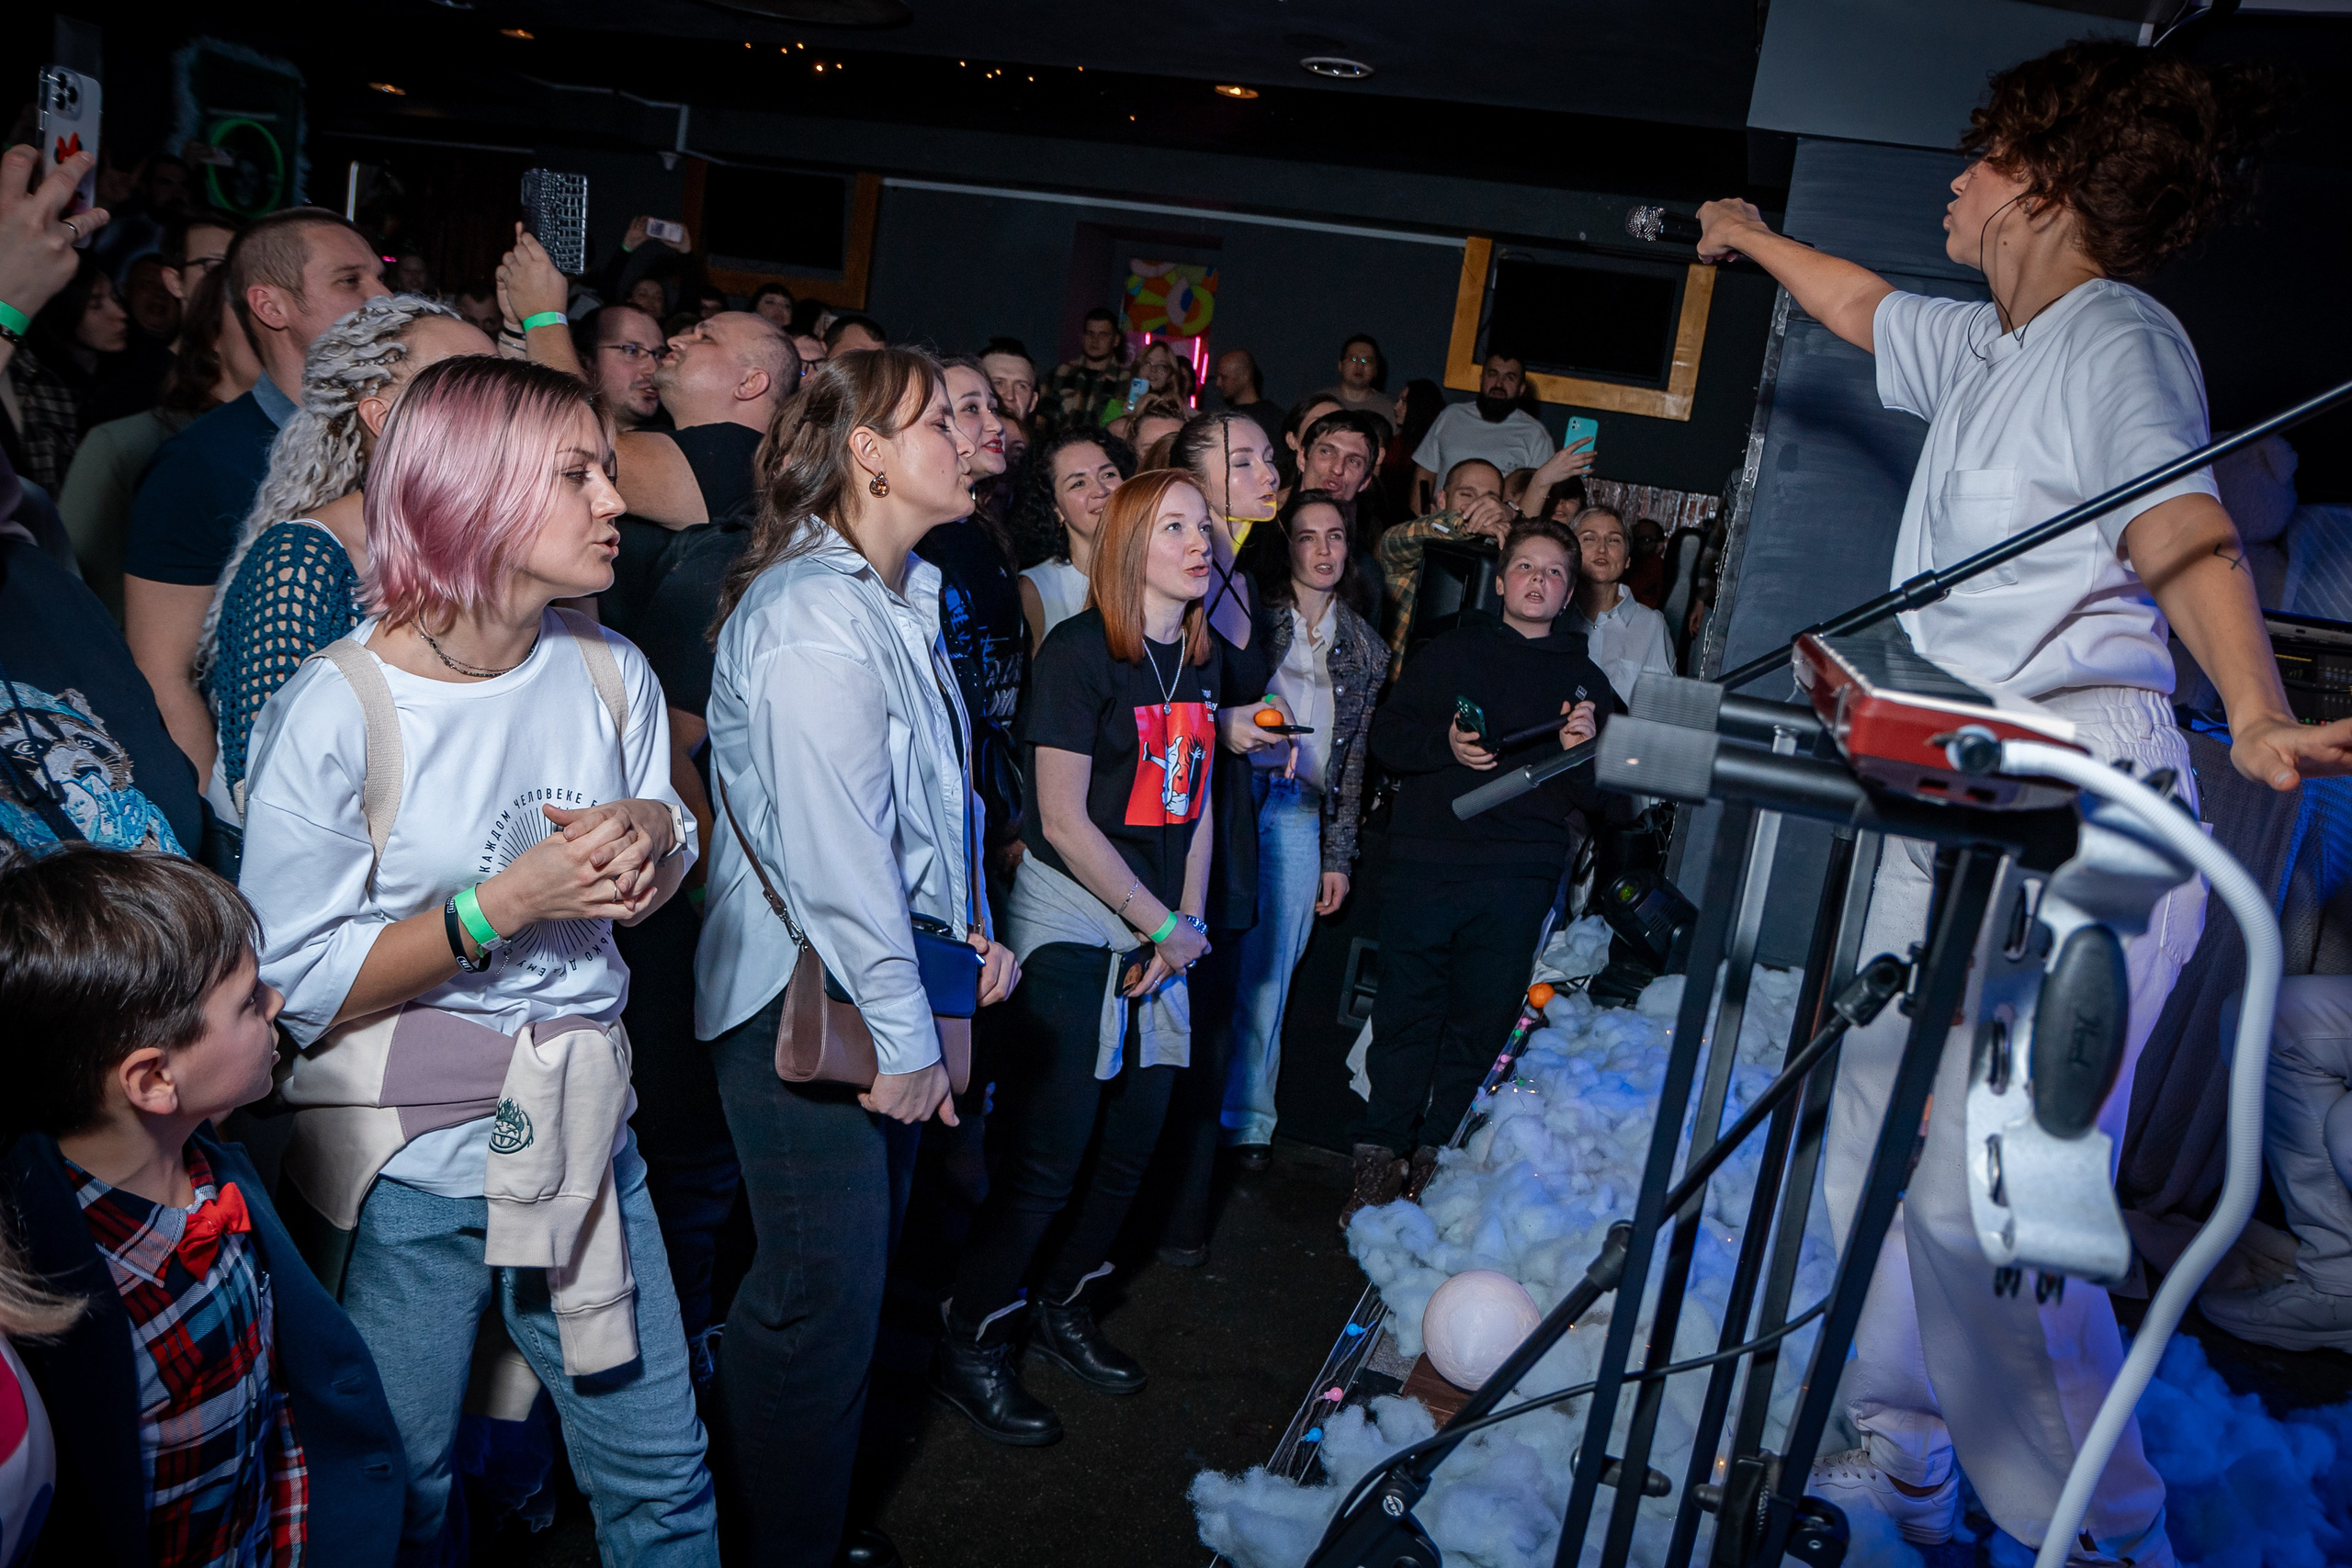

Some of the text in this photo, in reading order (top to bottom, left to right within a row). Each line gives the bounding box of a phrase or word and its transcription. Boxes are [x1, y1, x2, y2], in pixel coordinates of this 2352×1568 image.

[479, 787, 582, 874] КАЖДОМ ЧЕЛОВЕКЕ
[516, 959, 547, 977] ЕМУ
